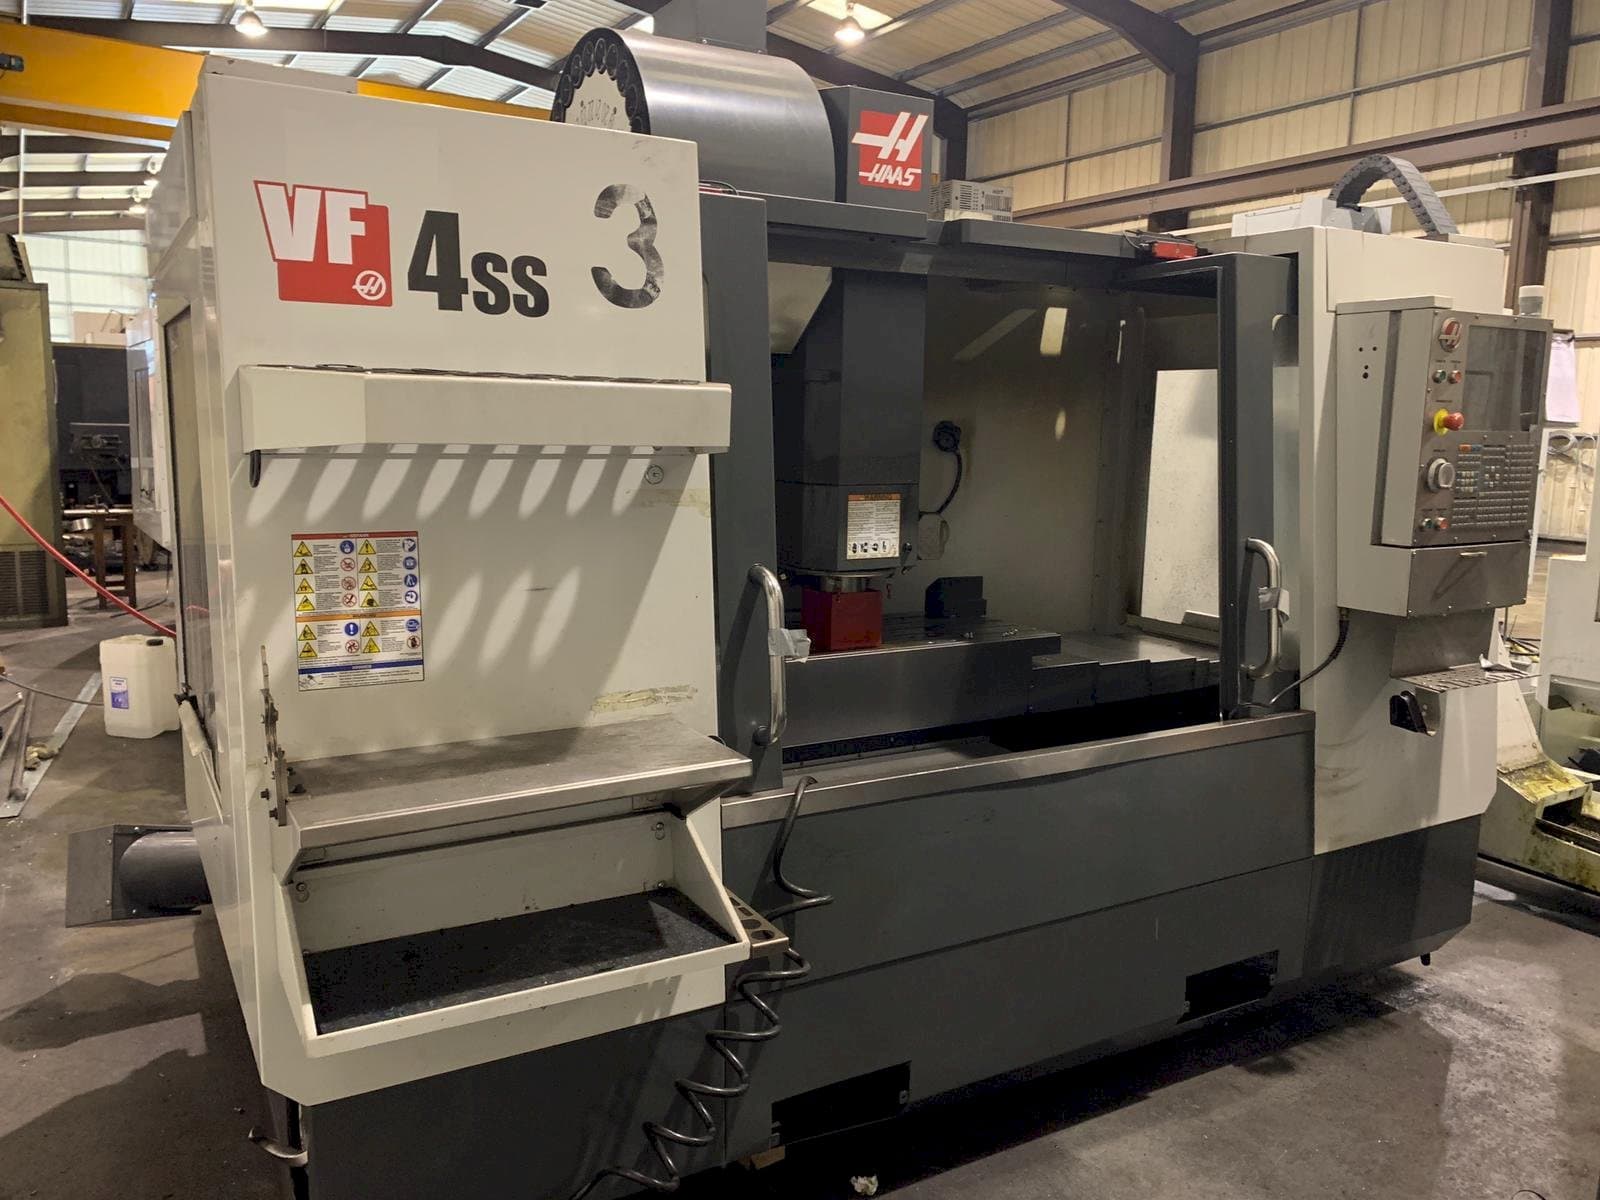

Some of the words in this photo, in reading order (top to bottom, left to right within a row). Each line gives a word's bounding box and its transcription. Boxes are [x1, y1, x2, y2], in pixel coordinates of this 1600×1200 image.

[859, 163, 922, 186] HAAS
[255, 181, 367, 265] VF
[591, 183, 665, 309] 3
